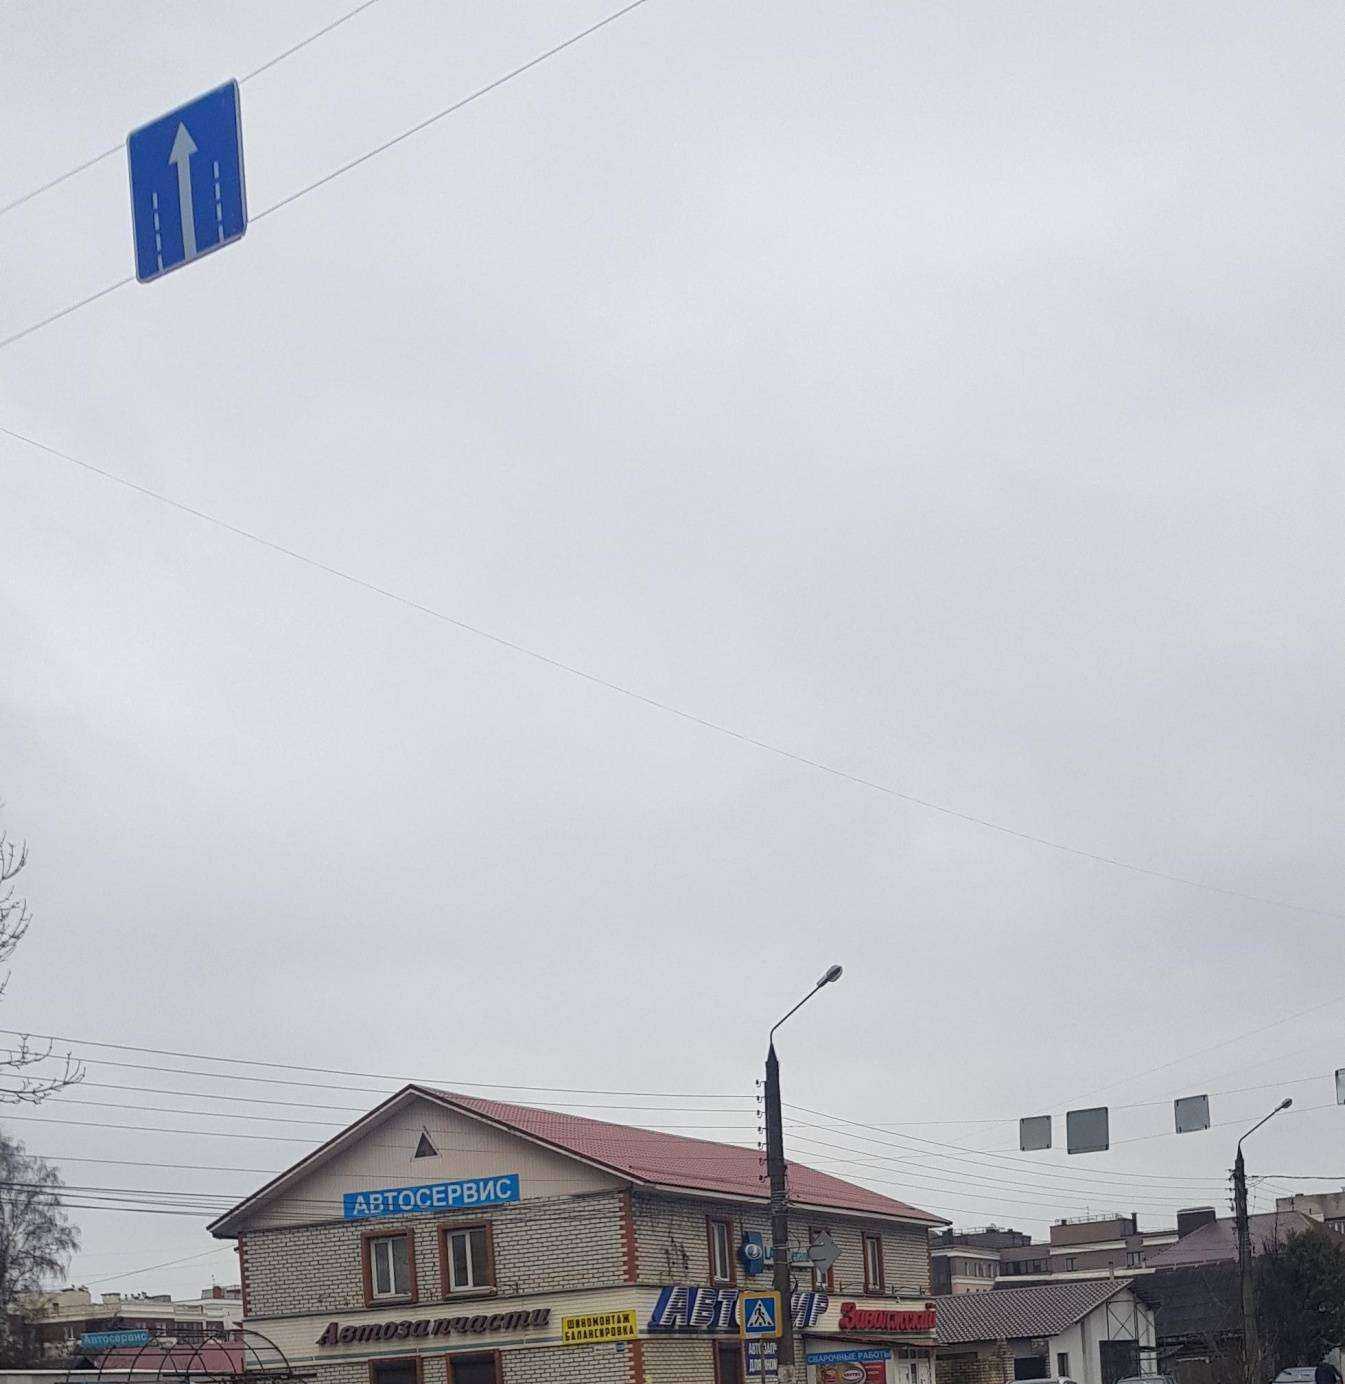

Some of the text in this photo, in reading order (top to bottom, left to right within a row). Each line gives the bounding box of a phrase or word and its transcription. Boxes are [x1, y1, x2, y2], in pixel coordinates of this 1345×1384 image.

[353, 1179, 512, 1216] АВТОСЕРВИС
[316, 1308, 551, 1346] Автозапчасти
[565, 1325, 634, 1341] БАЛАНСИРОВКА
[567, 1313, 630, 1329] ШИНОМОНТАЖ
